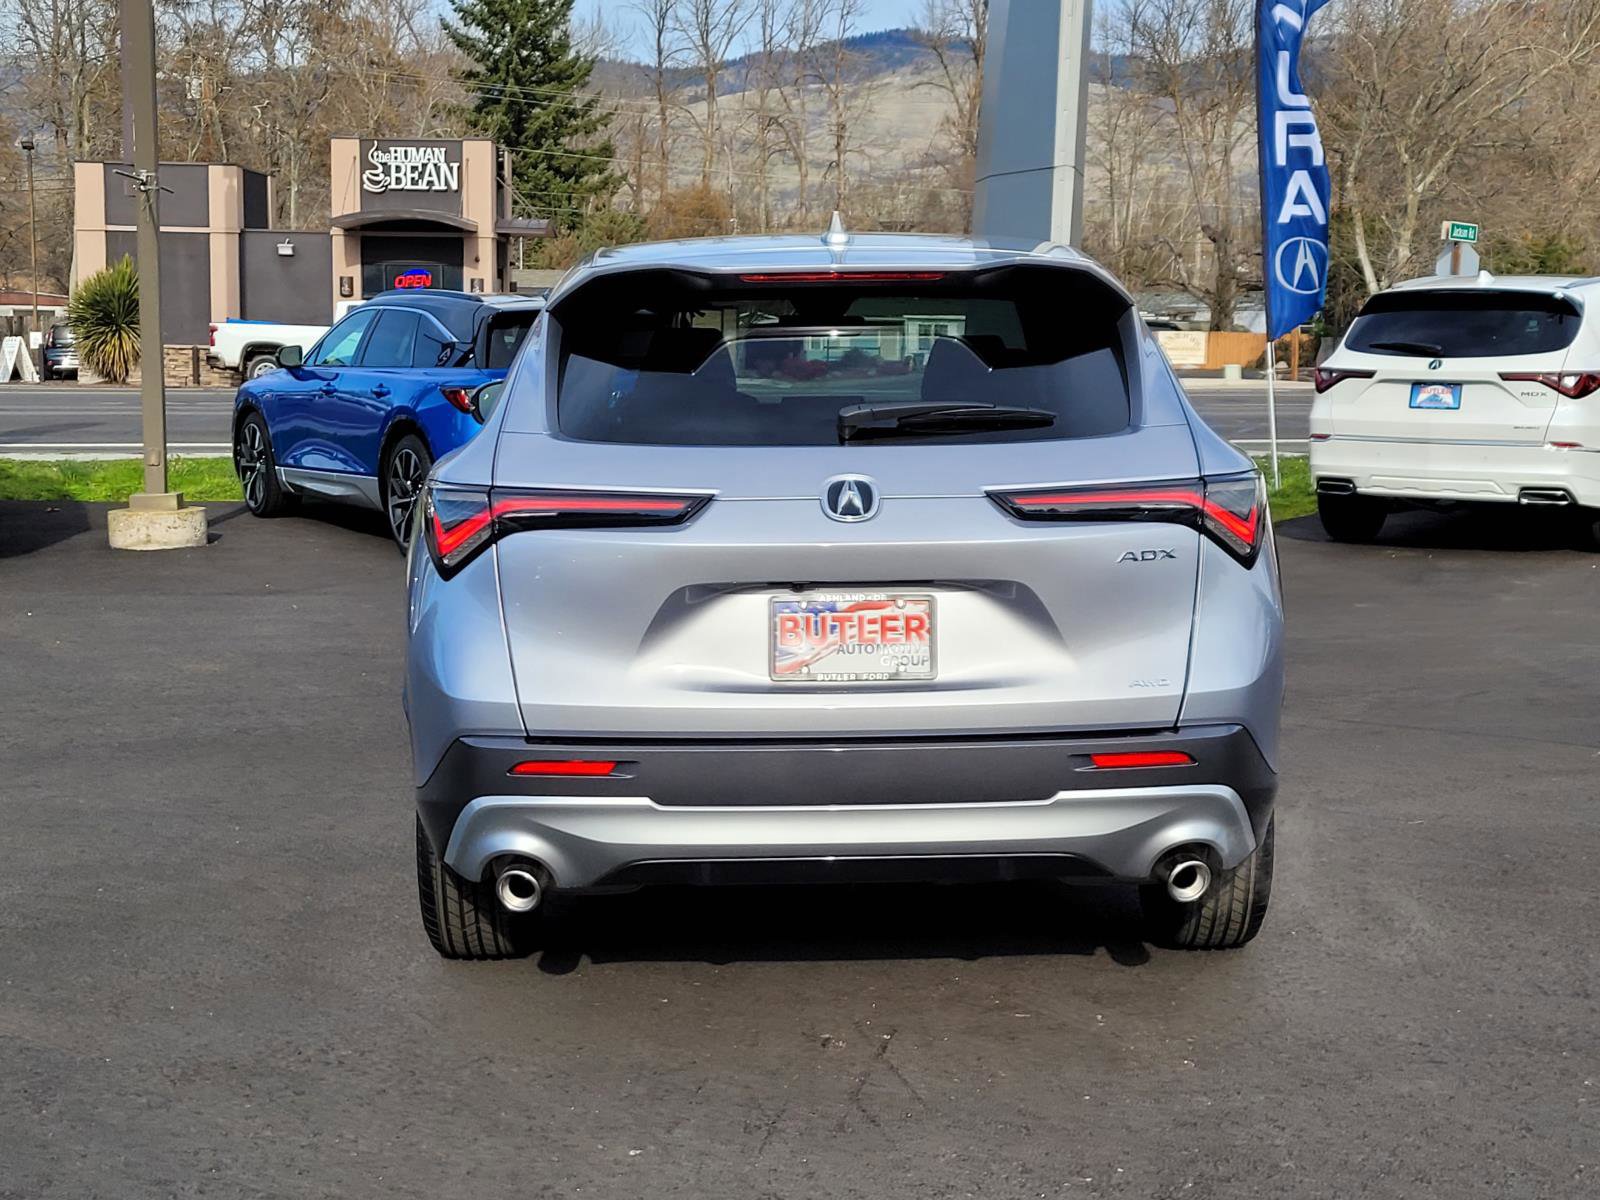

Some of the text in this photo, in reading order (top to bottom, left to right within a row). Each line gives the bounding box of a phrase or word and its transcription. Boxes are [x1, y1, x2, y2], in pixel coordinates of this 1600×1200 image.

[374, 146, 447, 163] the HUMAN
[387, 162, 460, 191] BEAN
[394, 274, 432, 289] OPEN
[1117, 548, 1177, 563] ADX
[778, 612, 930, 648] BUTLER
[880, 655, 930, 667] GROUP
[816, 673, 890, 682] BUTLER FORD
